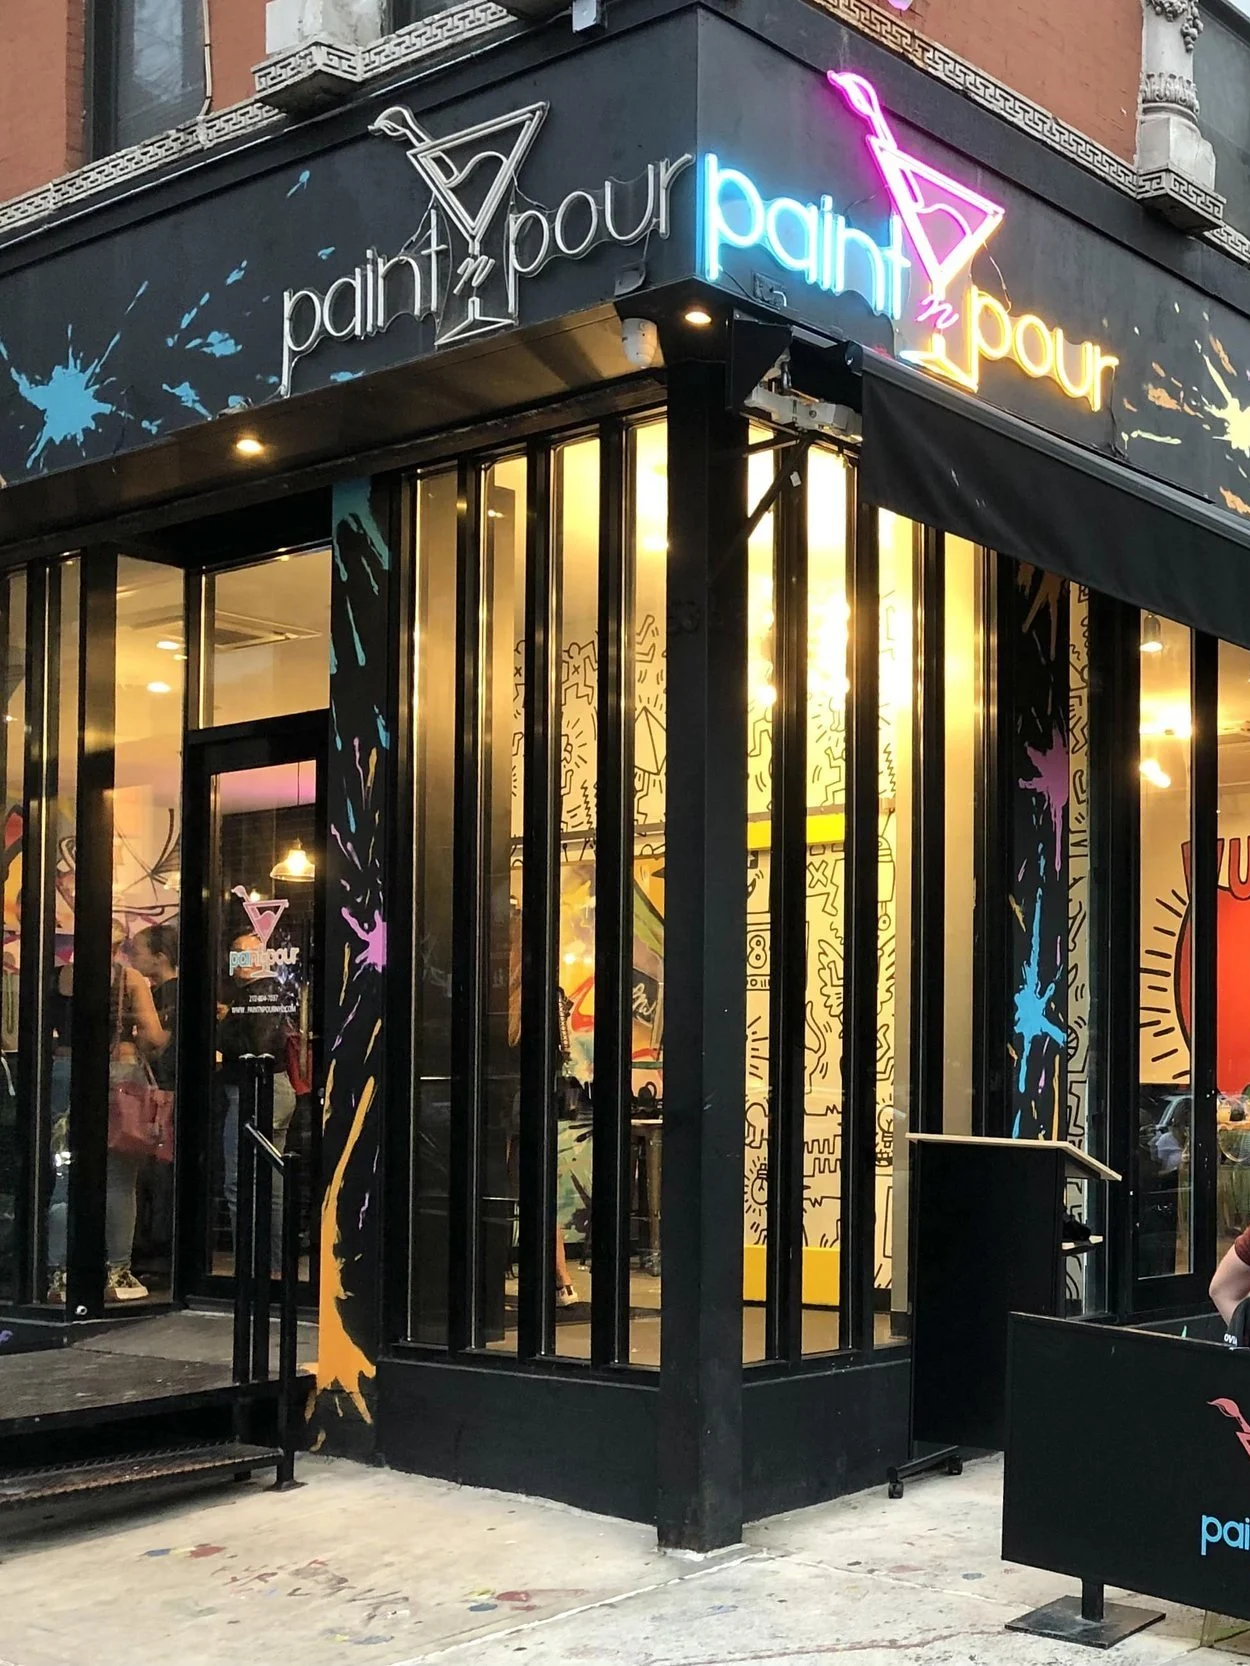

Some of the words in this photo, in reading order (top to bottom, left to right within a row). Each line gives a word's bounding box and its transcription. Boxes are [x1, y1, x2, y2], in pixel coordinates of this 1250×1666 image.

[281, 206, 450, 398] paint
[508, 152, 693, 316] pour
[704, 152, 912, 320] paint
[966, 284, 1121, 412] pour
